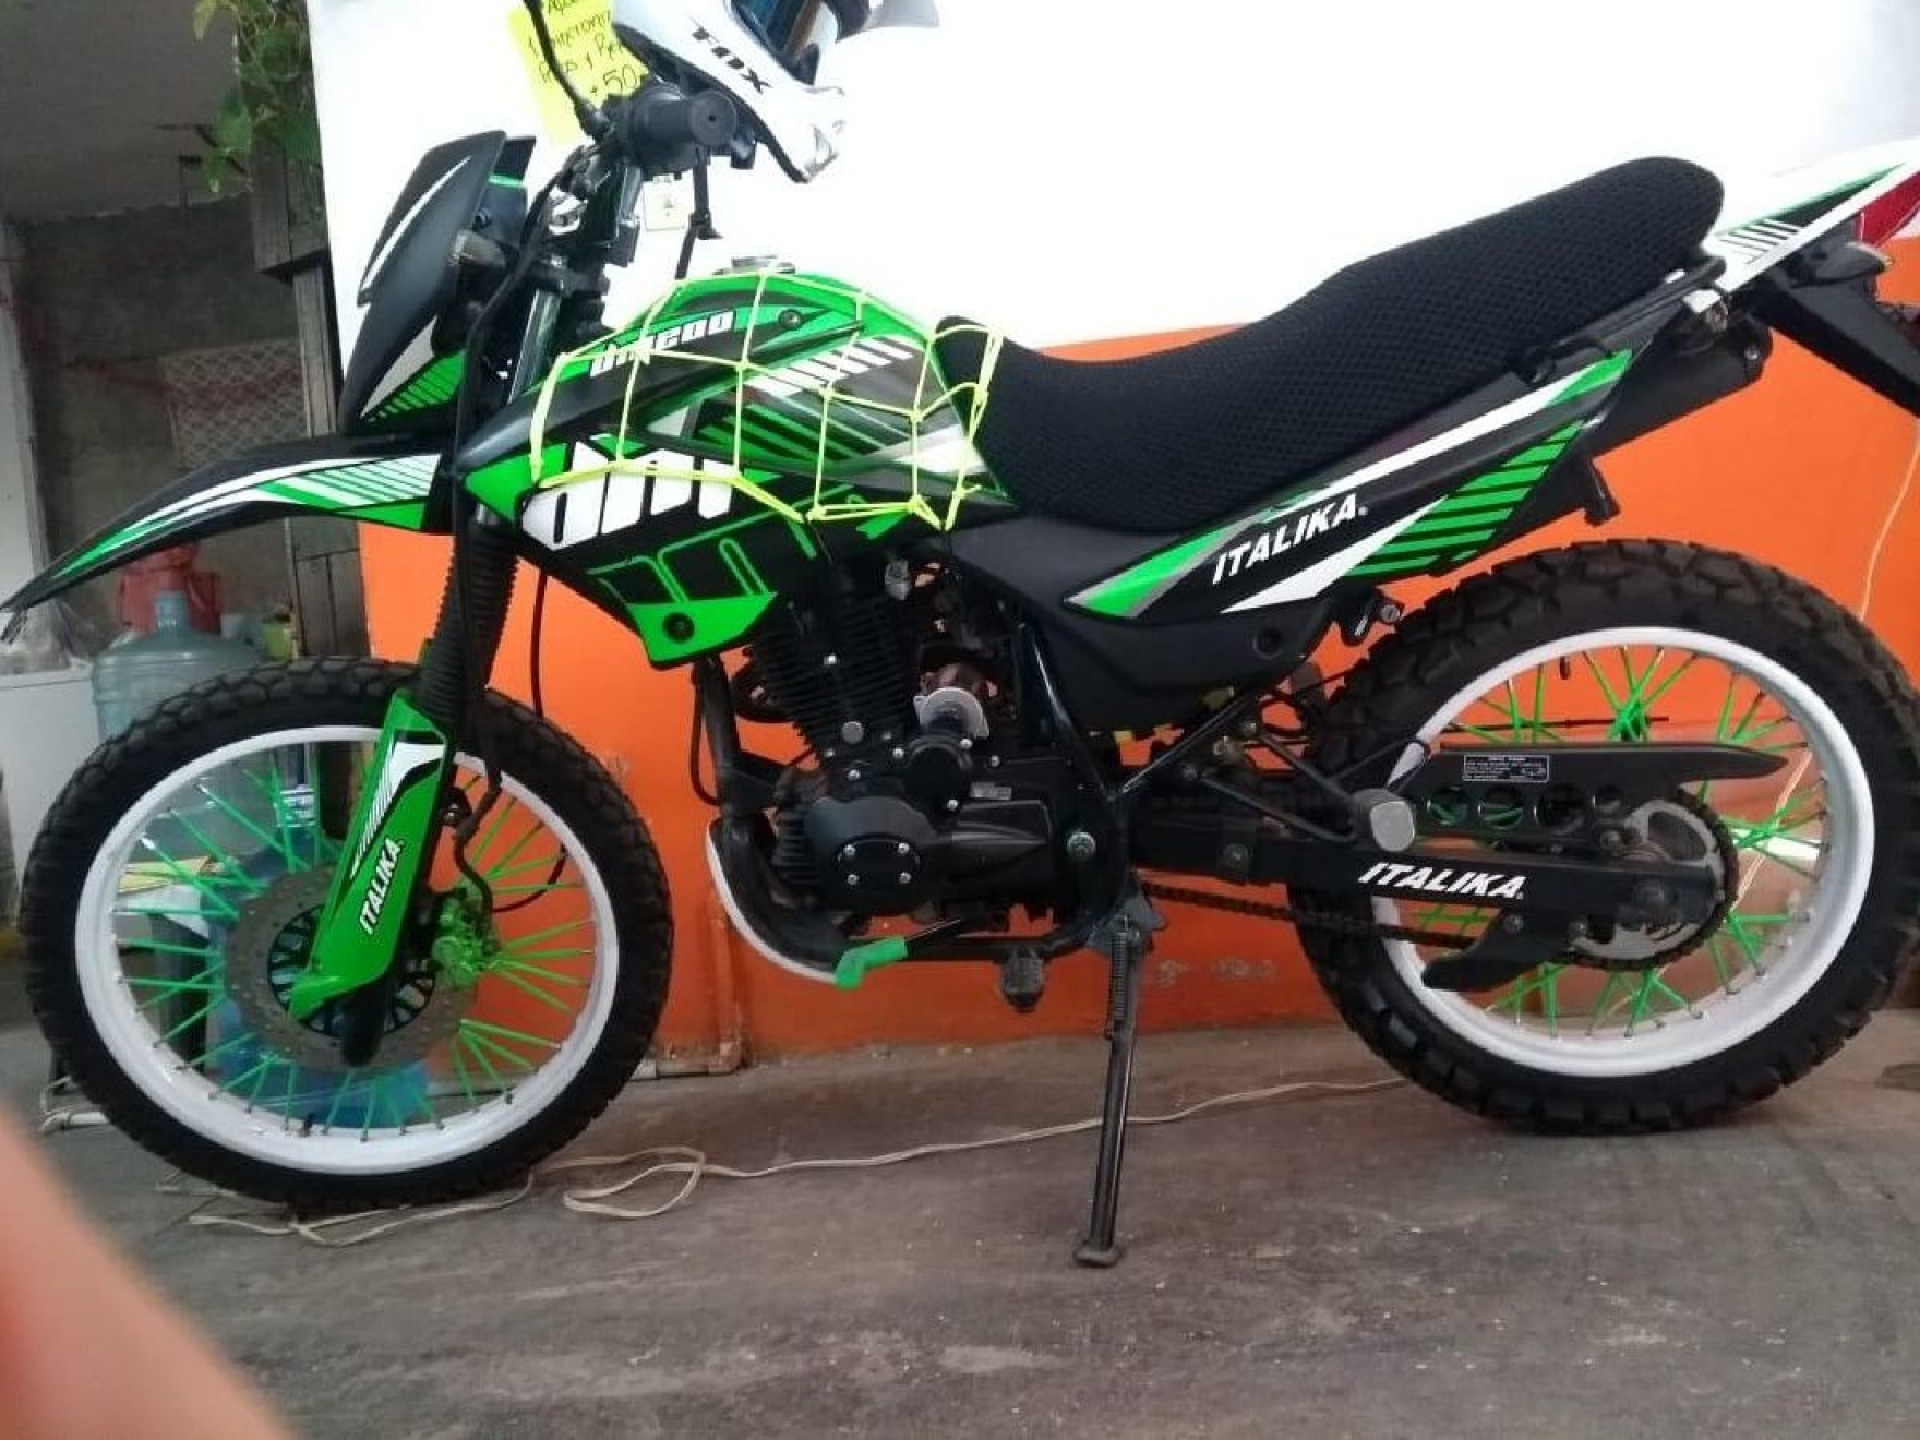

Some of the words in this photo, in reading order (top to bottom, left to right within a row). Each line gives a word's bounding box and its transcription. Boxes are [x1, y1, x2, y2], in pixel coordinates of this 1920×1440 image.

[1212, 493, 1357, 585] ITALIKA
[360, 837, 401, 935] ITALIKA
[1358, 862, 1526, 900] ITALIKA
